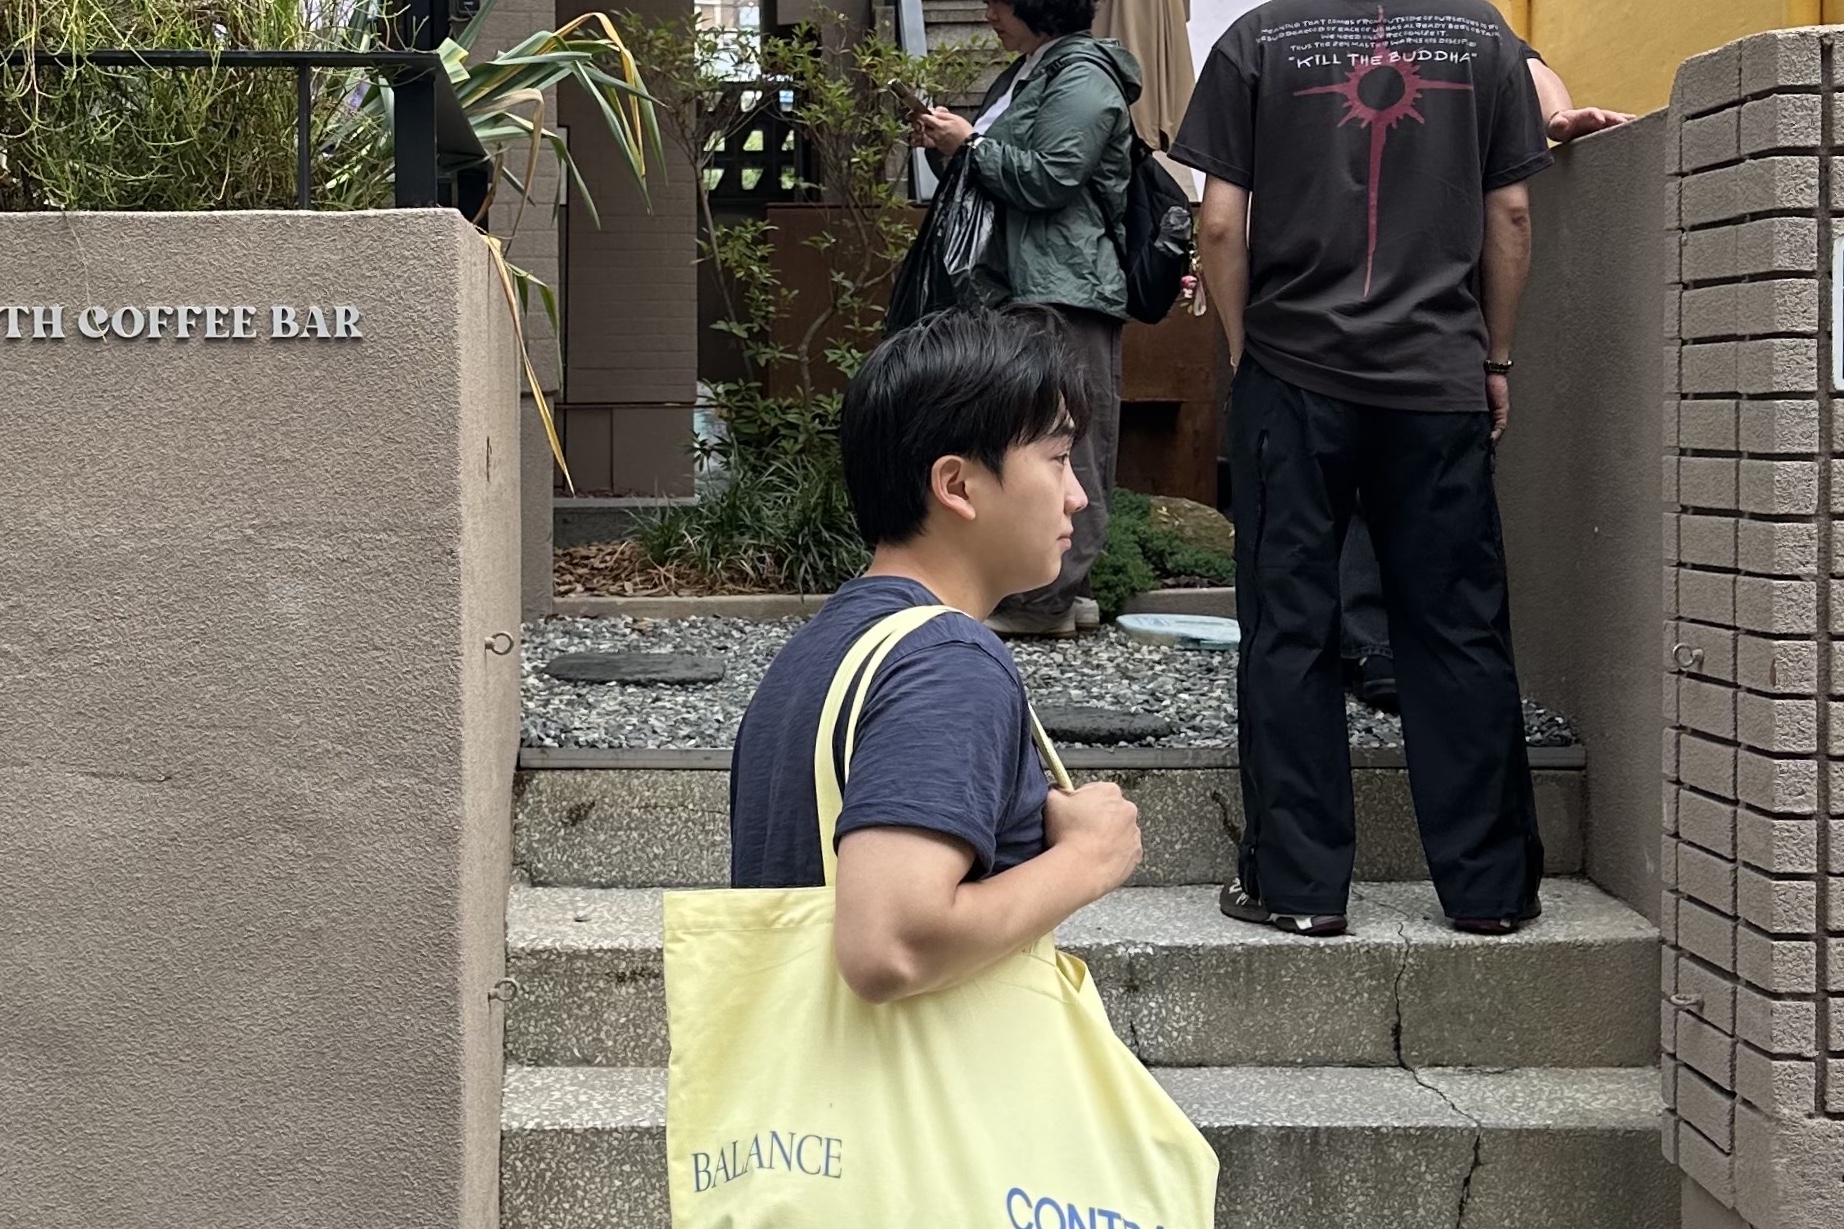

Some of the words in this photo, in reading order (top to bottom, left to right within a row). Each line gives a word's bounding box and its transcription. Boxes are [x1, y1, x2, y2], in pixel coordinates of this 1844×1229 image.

[1302, 19, 1326, 27] THAT
[1347, 53, 1383, 67] THE
[77, 306, 257, 339] COFFEE
[270, 306, 363, 339] BAR
[691, 1130, 843, 1193] BALANCE
